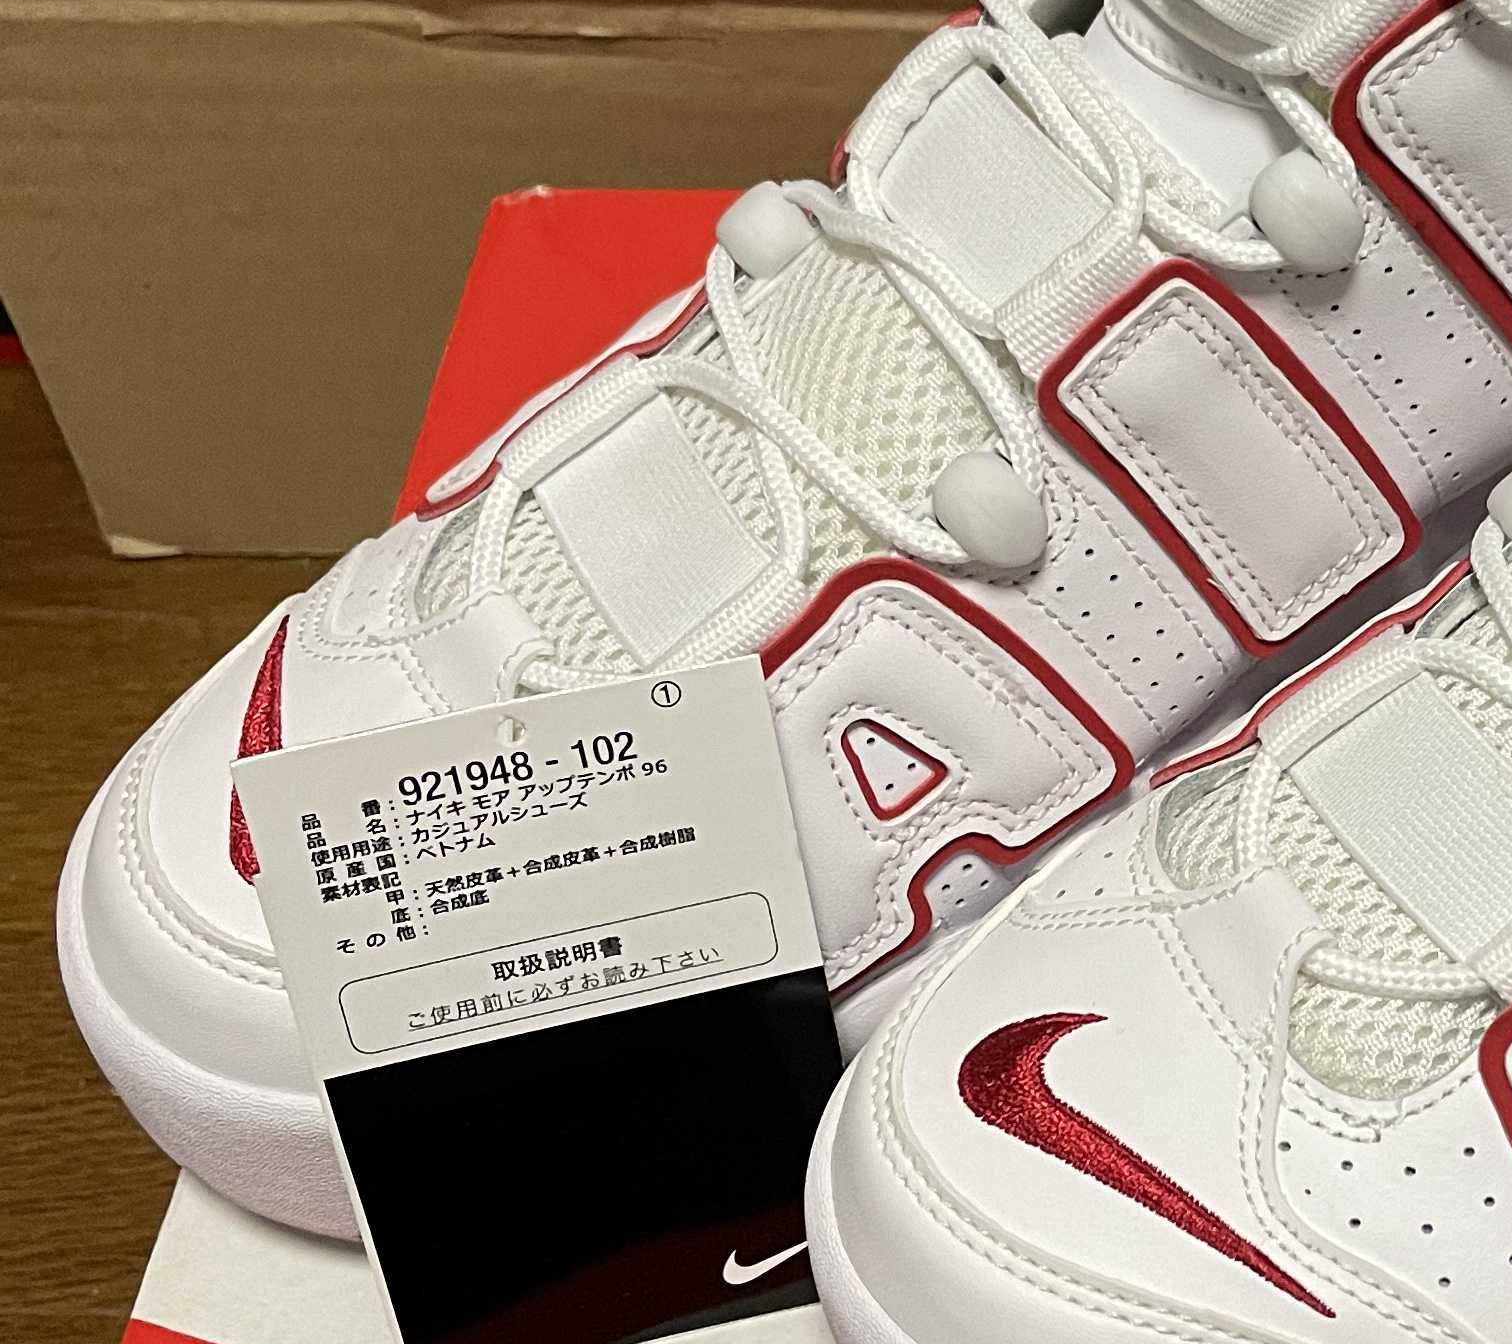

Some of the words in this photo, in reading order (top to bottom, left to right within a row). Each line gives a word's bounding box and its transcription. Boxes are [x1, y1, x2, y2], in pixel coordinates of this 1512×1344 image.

[398, 751, 534, 806] 921948
[570, 731, 638, 769] 102
[641, 758, 668, 777] 96
[416, 832, 496, 860] ベトナム
[490, 936, 623, 982] 取扱説明書
[408, 947, 720, 1029] ご使用前に必ずお読み下さい
